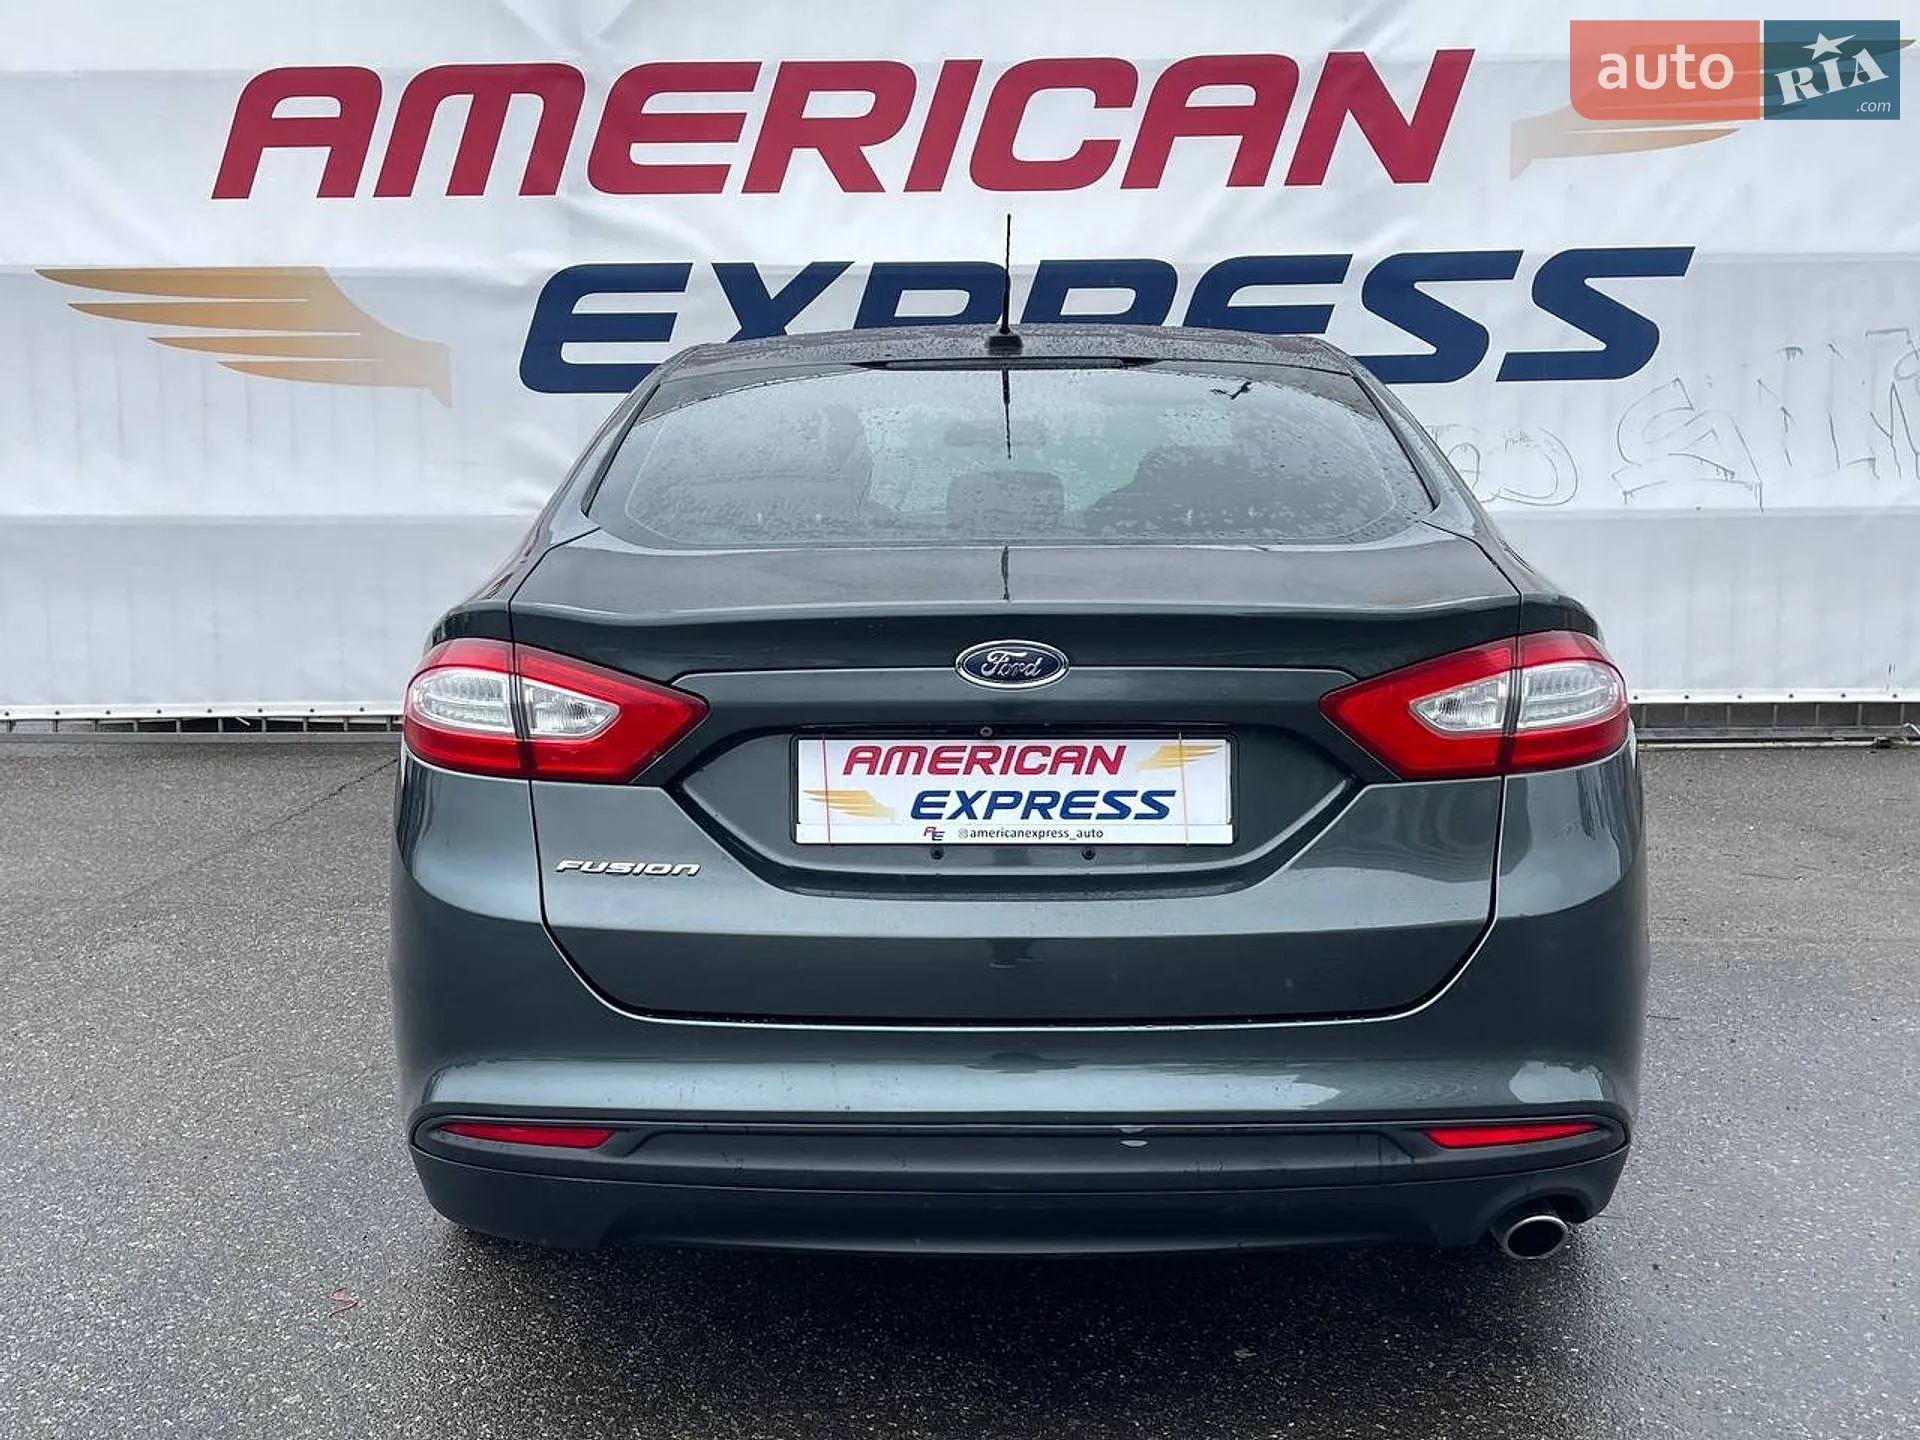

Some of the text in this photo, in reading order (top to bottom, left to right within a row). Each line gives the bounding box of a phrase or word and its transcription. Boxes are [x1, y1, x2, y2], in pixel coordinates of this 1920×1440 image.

[213, 49, 1472, 198] AMERICAN
[981, 650, 1043, 677] Ford
[843, 744, 1126, 775] AMERICAN
[909, 789, 1177, 821] EXPRESS
[555, 859, 702, 877] FUSION
